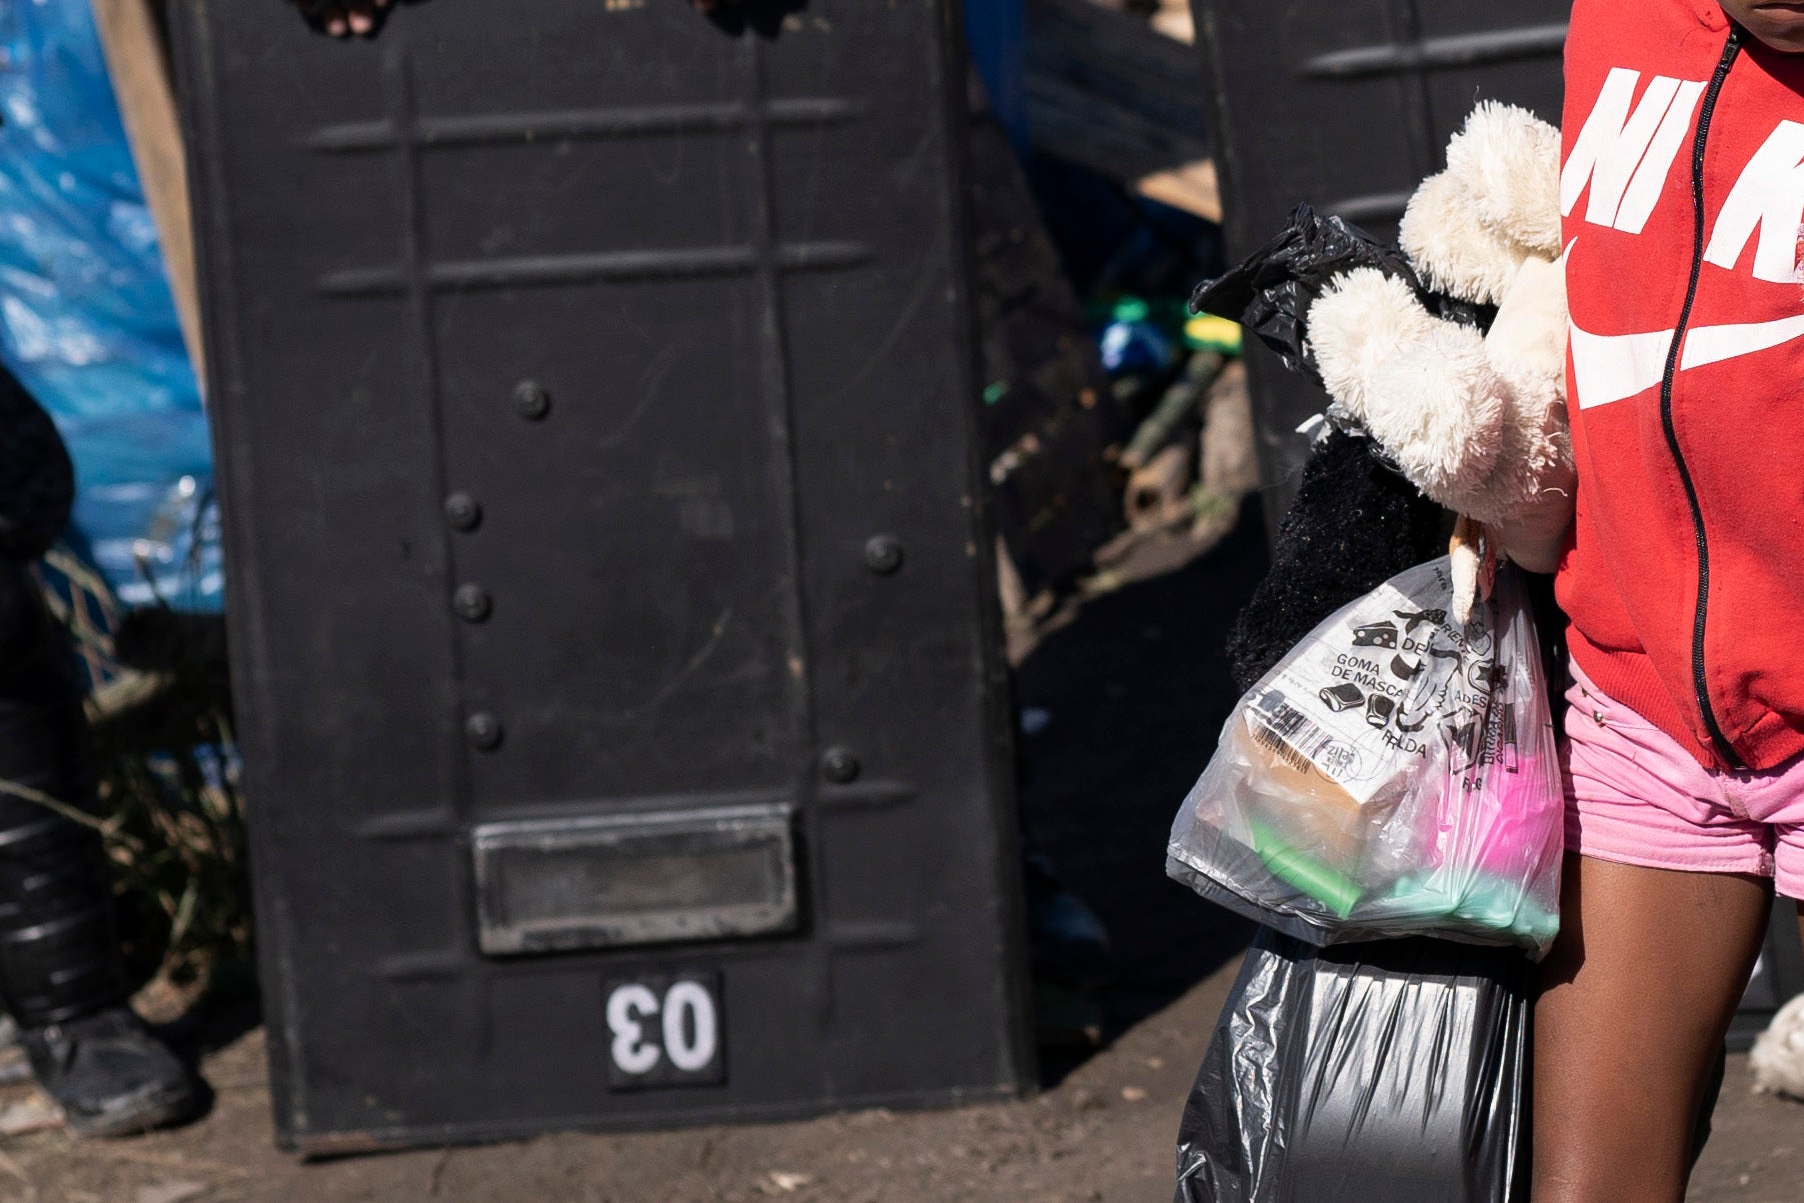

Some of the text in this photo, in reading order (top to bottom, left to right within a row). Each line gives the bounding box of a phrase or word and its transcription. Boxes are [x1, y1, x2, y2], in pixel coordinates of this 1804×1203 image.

[1336, 653, 1380, 676] GOMA
[1330, 665, 1405, 699] DE MASCA
[1455, 690, 1487, 708] ADES
[606, 981, 717, 1073] 03
